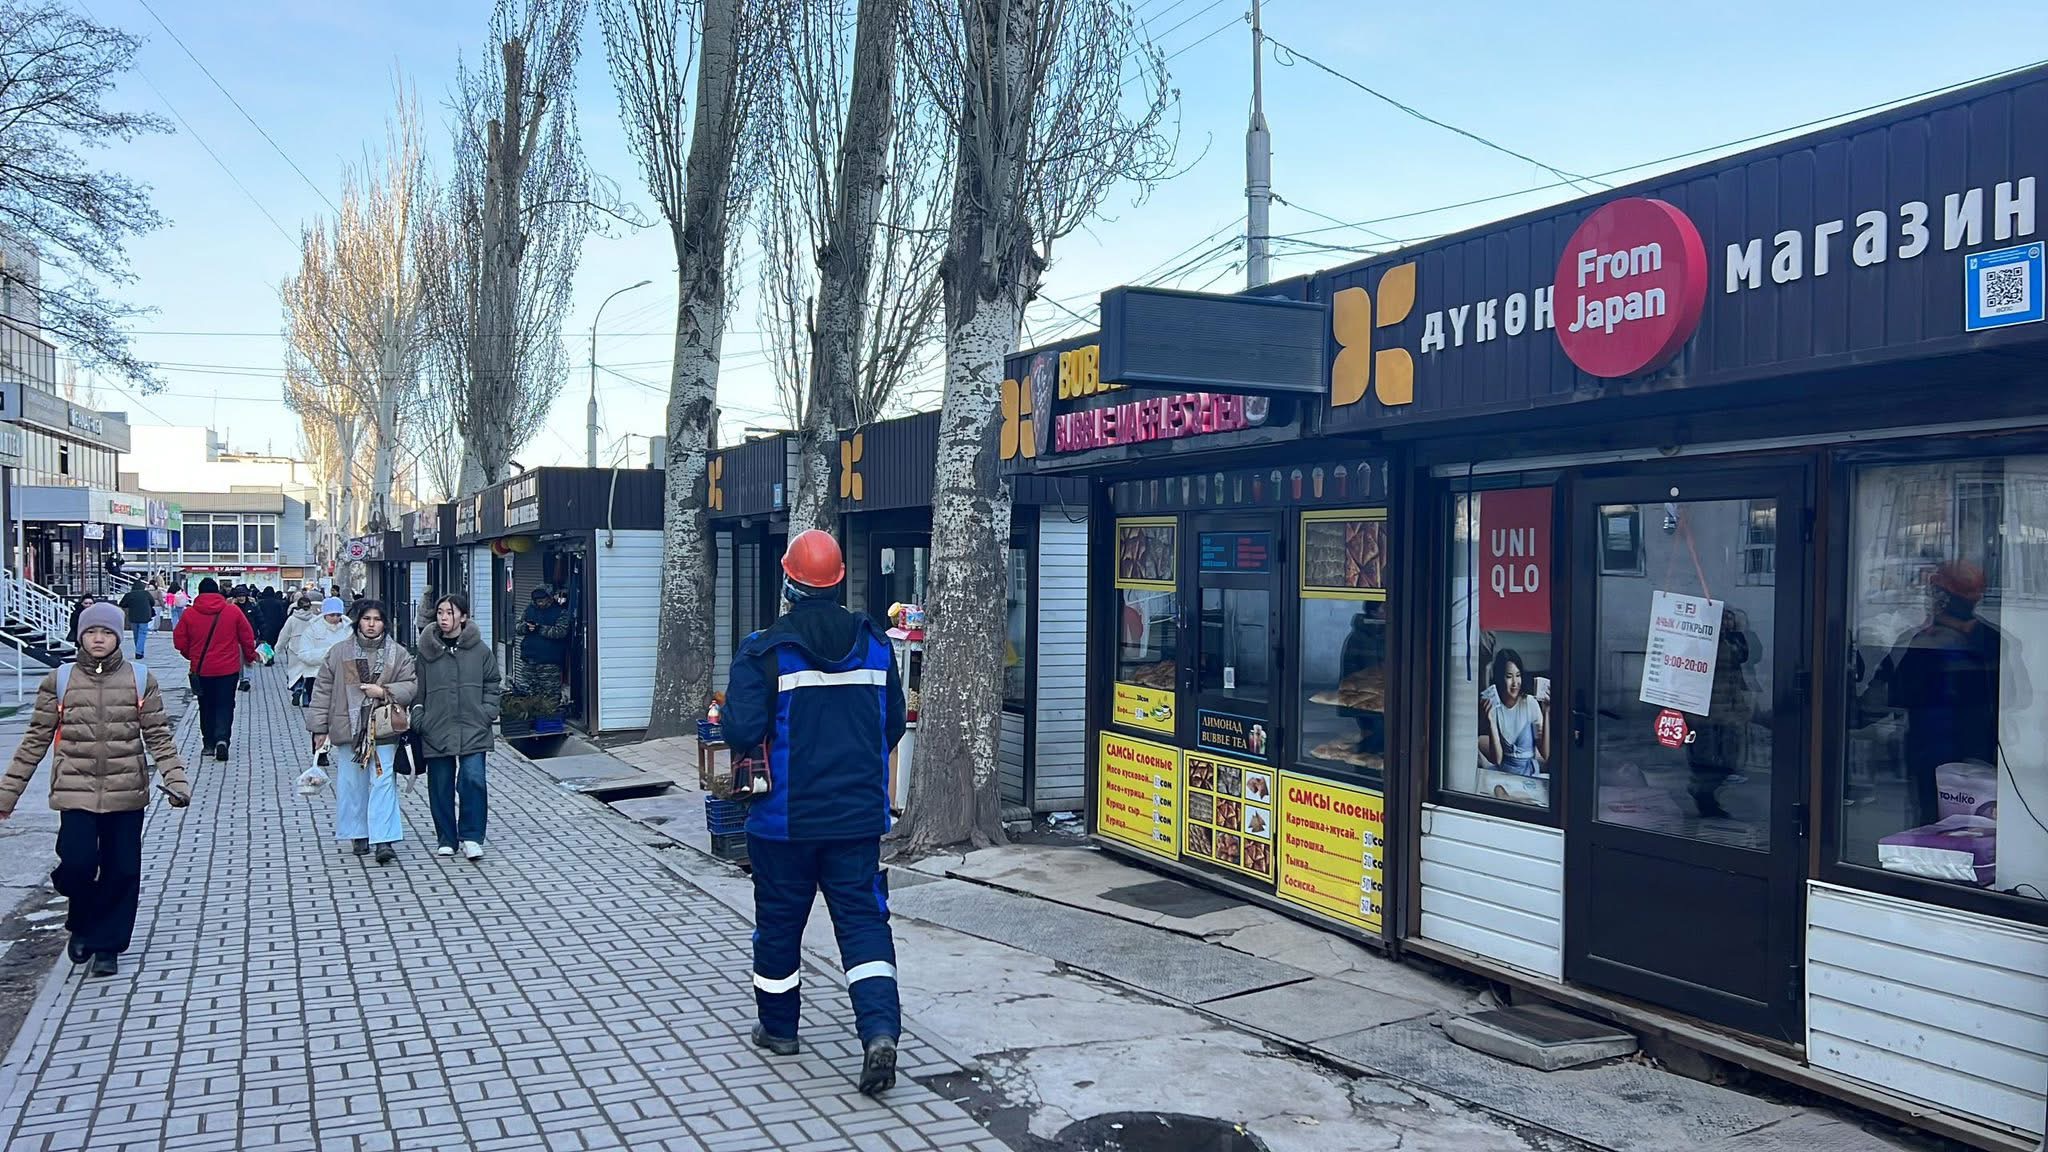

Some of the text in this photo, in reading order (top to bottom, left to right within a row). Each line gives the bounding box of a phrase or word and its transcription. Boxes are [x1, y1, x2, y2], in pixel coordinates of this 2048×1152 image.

[1726, 176, 2036, 294] магазин
[1577, 242, 1662, 288] From
[1568, 287, 1665, 334] Japan
[1055, 407, 1116, 452] BUBBLE
[1117, 393, 1193, 445] WAFFLES
[1206, 394, 1249, 432] TEA
[1491, 527, 1535, 557] UNI
[1491, 564, 1539, 598] QLO
[1681, 620, 1714, 636] ОТКРЫТО
[1664, 656, 1708, 674] 9:00-20:00
[1202, 716, 1243, 734] ЛИМОНАД
[1202, 731, 1248, 749] BUBBLE TEA
[1106, 743, 1173, 771] САМСЫ слоеные
[1106, 763, 1121, 775] Мясо
[1122, 769, 1149, 782] кусковой
[1106, 780, 1145, 799] Мясо+курица
[1288, 787, 1330, 811] САМСЫ
[1106, 797, 1126, 812] Курица
[1128, 805, 1141, 816] сыр
[1105, 814, 1126, 829] Курица
[1286, 833, 1324, 853] Картошка
[1286, 854, 1309, 870] Тыква
[1284, 874, 1315, 893] Сосиска
